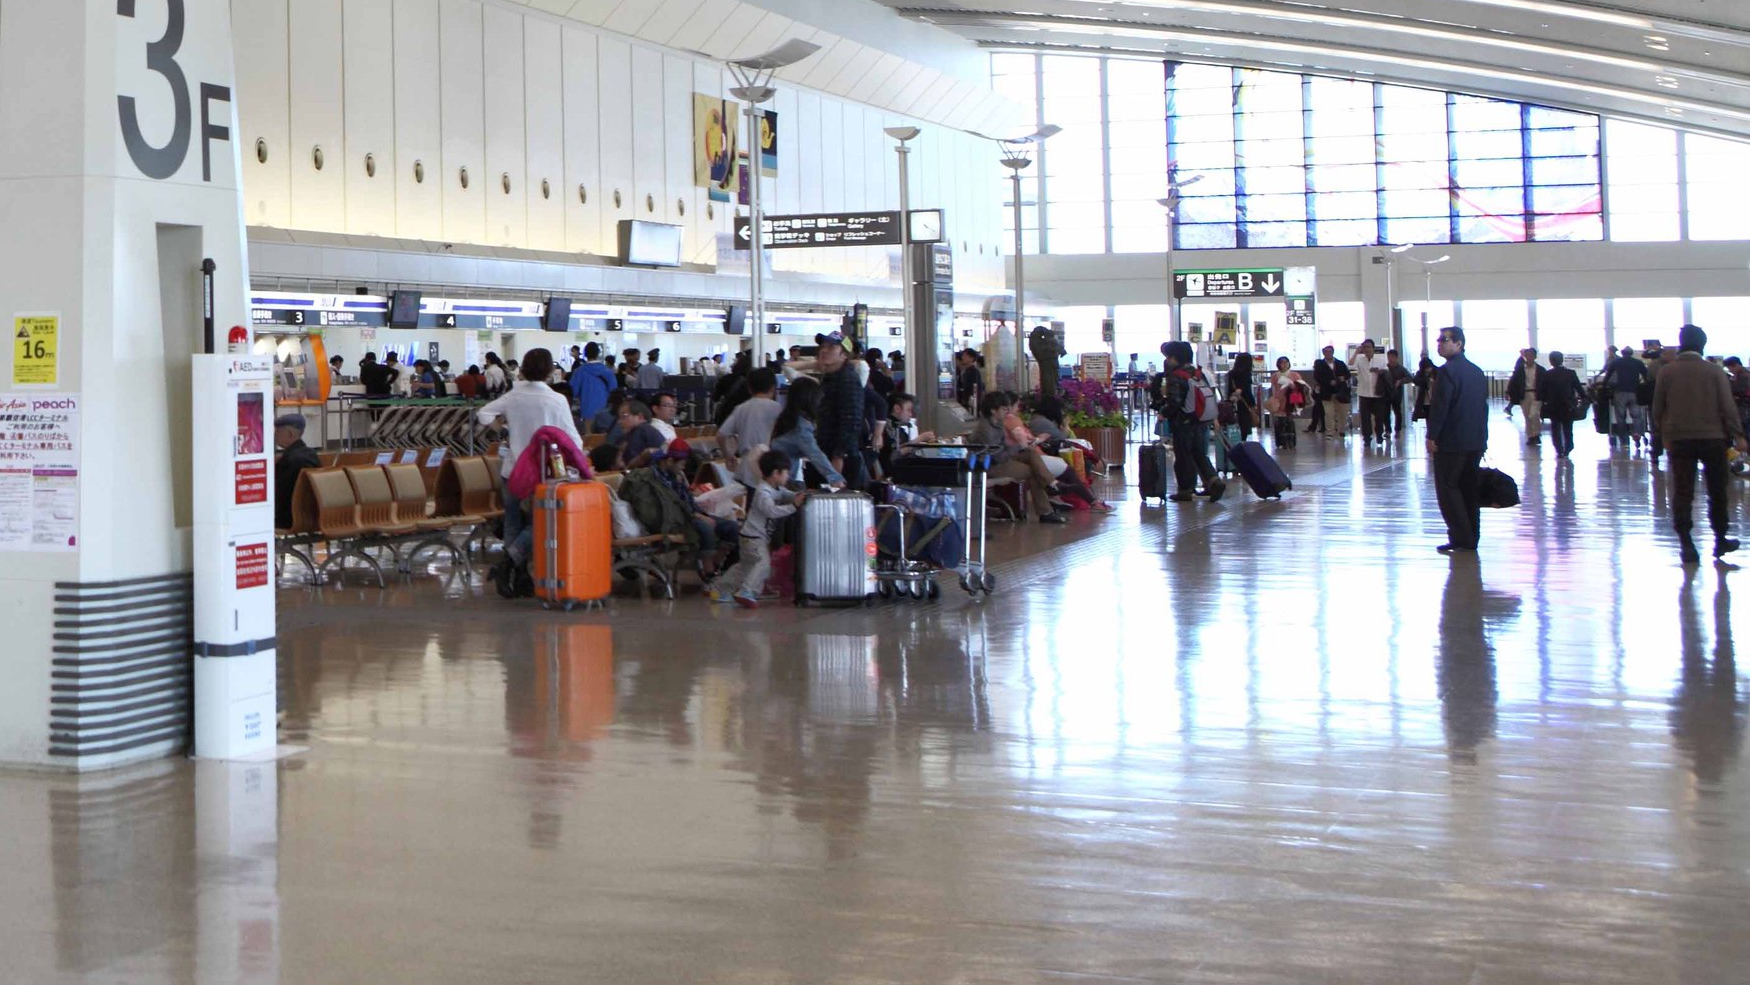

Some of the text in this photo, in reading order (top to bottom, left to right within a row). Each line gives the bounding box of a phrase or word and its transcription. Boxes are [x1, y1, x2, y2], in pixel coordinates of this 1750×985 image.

[1238, 273, 1253, 289] B
[295, 312, 303, 323] 3
[446, 317, 455, 326] 4
[614, 321, 621, 329] 5
[672, 322, 680, 330] 6
[32, 397, 76, 411] peach
